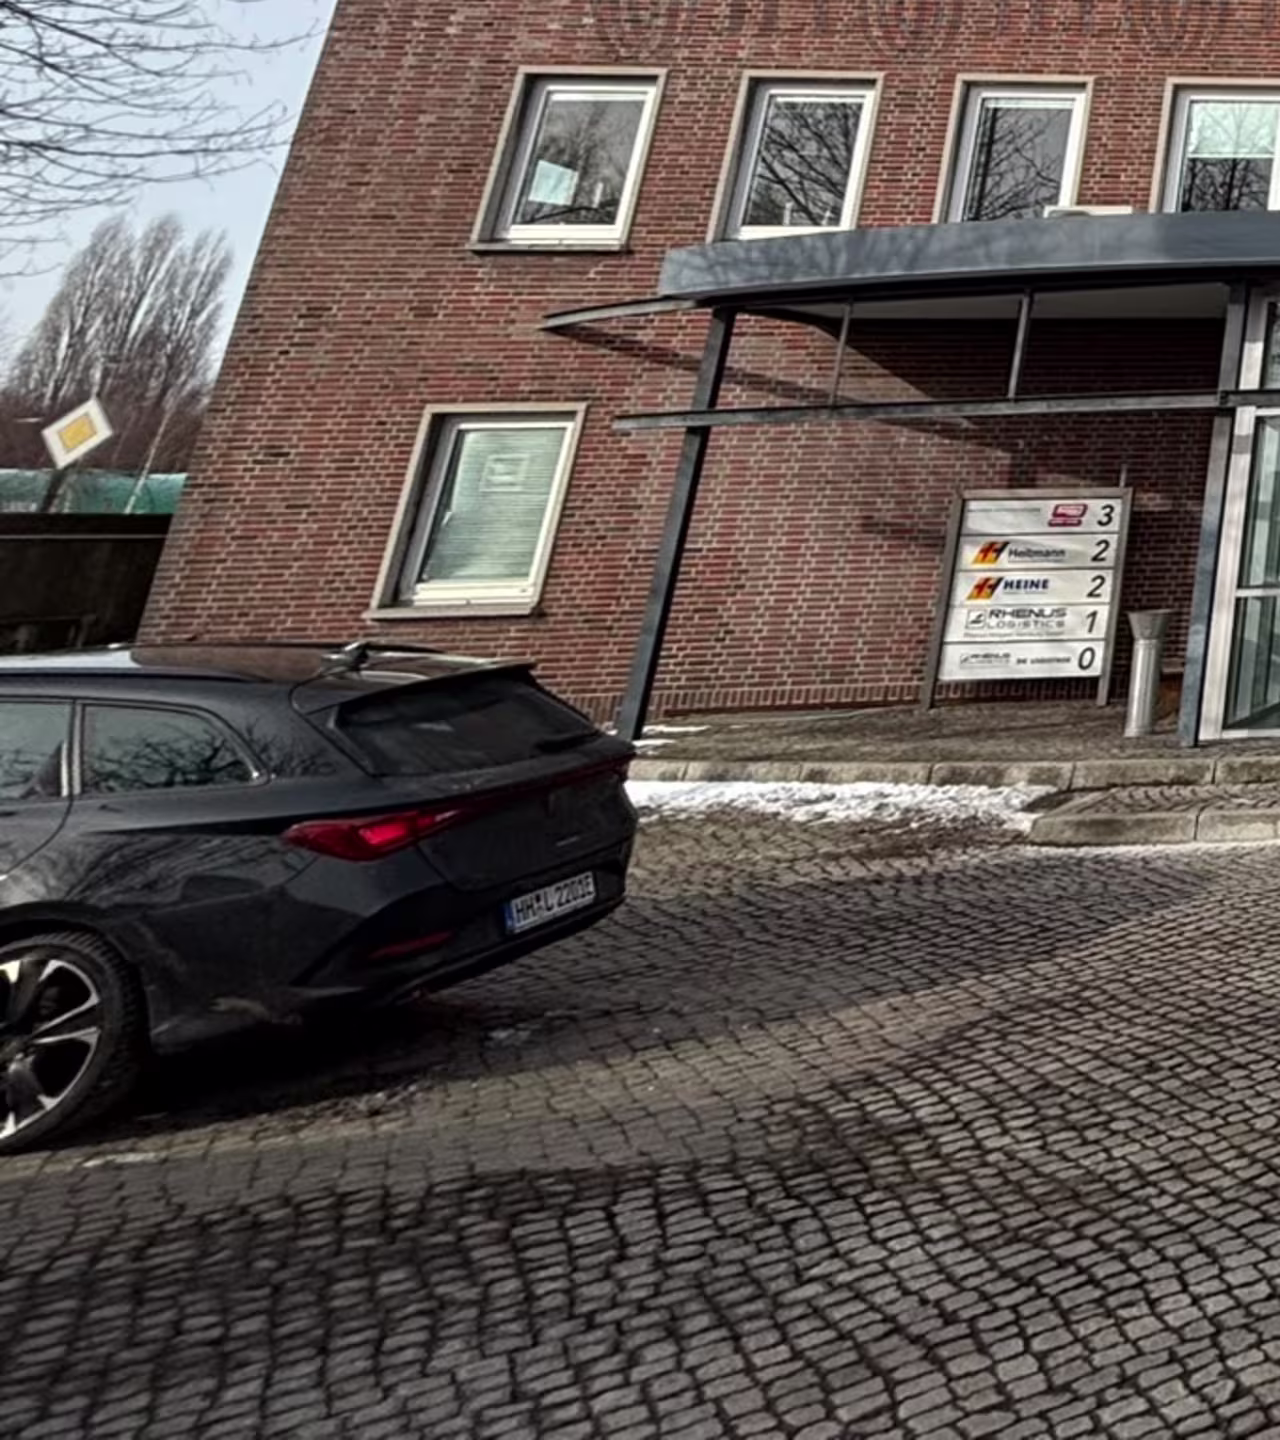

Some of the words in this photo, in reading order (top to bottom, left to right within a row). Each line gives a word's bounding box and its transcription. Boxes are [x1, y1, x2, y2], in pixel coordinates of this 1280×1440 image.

[1097, 504, 1115, 527] 3
[1090, 539, 1110, 561] 2
[1003, 578, 1049, 590] HEINE
[1086, 575, 1105, 598] 2
[987, 620, 1065, 629] LOGISTICS
[988, 608, 1067, 619] RHENUS
[1086, 610, 1098, 634] 1
[1078, 647, 1095, 670] 0
